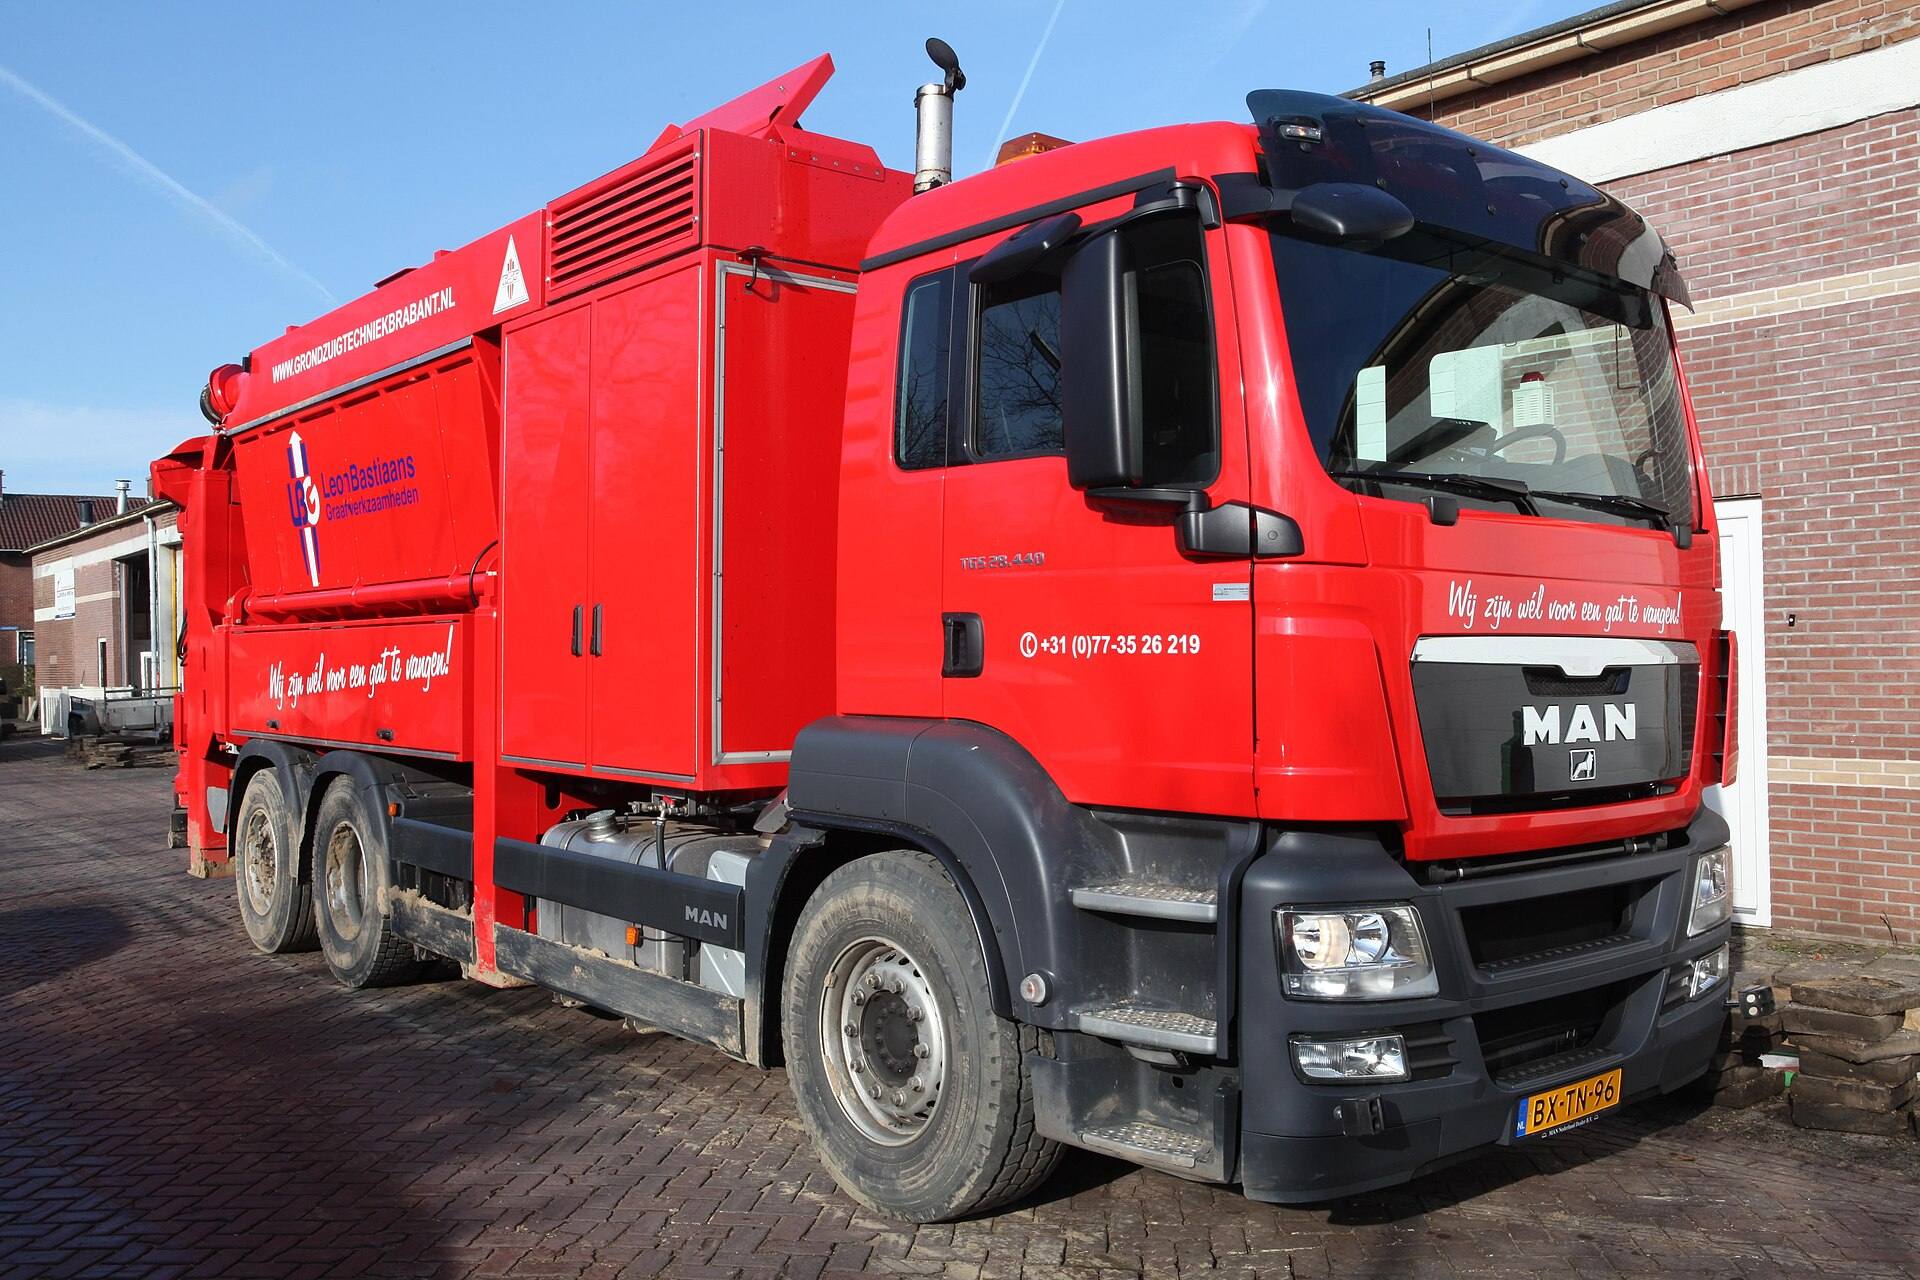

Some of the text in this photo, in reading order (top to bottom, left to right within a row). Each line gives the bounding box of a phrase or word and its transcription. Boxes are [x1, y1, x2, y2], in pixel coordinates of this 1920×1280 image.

[271, 286, 456, 384] WWW.GRONDZUIGTECHNIEKBRABANT.NL
[988, 551, 1045, 568] 28.440
[1448, 579, 1682, 634] Wij zijn wél voor een gat te vangen!
[269, 624, 454, 711] Wij zijn wél voor een gat te vangen!
[1040, 634, 1200, 659] +31 (0)77-35 26 219
[1522, 703, 1636, 746] MAN
[685, 904, 728, 930] MAN
[1516, 1075, 1615, 1131] NL BX-TN-96
